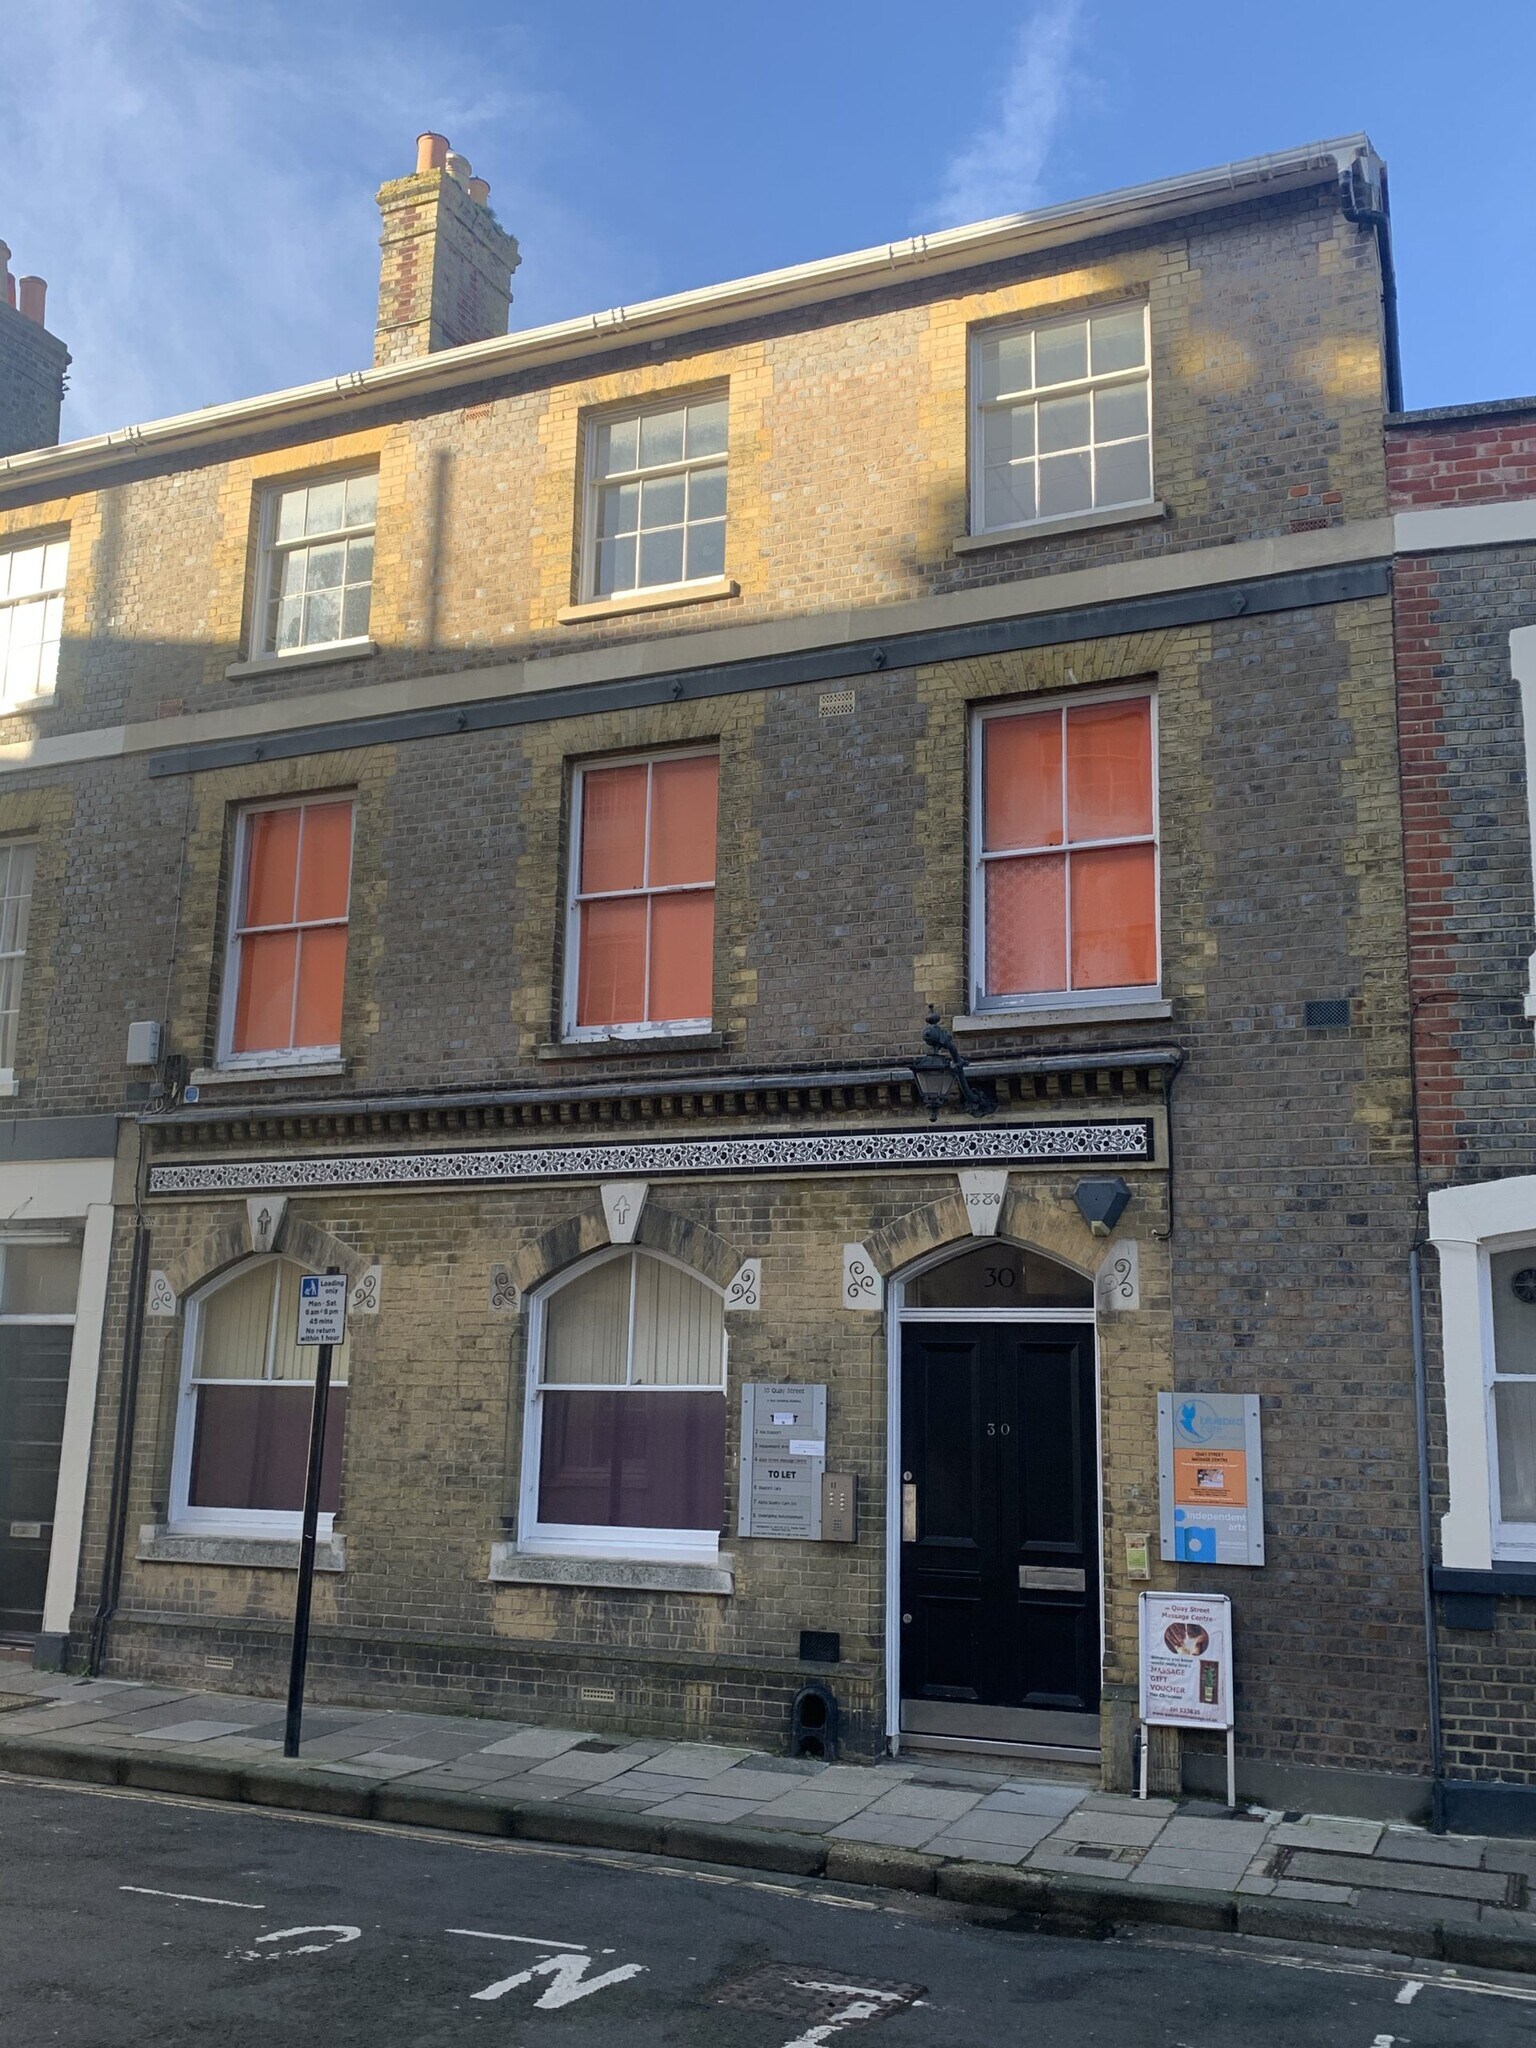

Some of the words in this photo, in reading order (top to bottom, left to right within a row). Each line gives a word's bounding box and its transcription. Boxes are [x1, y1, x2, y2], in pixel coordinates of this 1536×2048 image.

[984, 1267, 1015, 1288] 30
[771, 1387, 785, 1395] Quay
[987, 1423, 1010, 1436] 30
[768, 1470, 779, 1478] TO
[781, 1471, 797, 1479] LET
[1187, 1511, 1247, 1522] independent
[1228, 1524, 1247, 1532] arts
[1162, 1612, 1190, 1621] Massage
[1191, 1614, 1213, 1622] Centre
[1150, 1666, 1185, 1676] MASSAGE
[1150, 1684, 1186, 1694] VOUCHER
